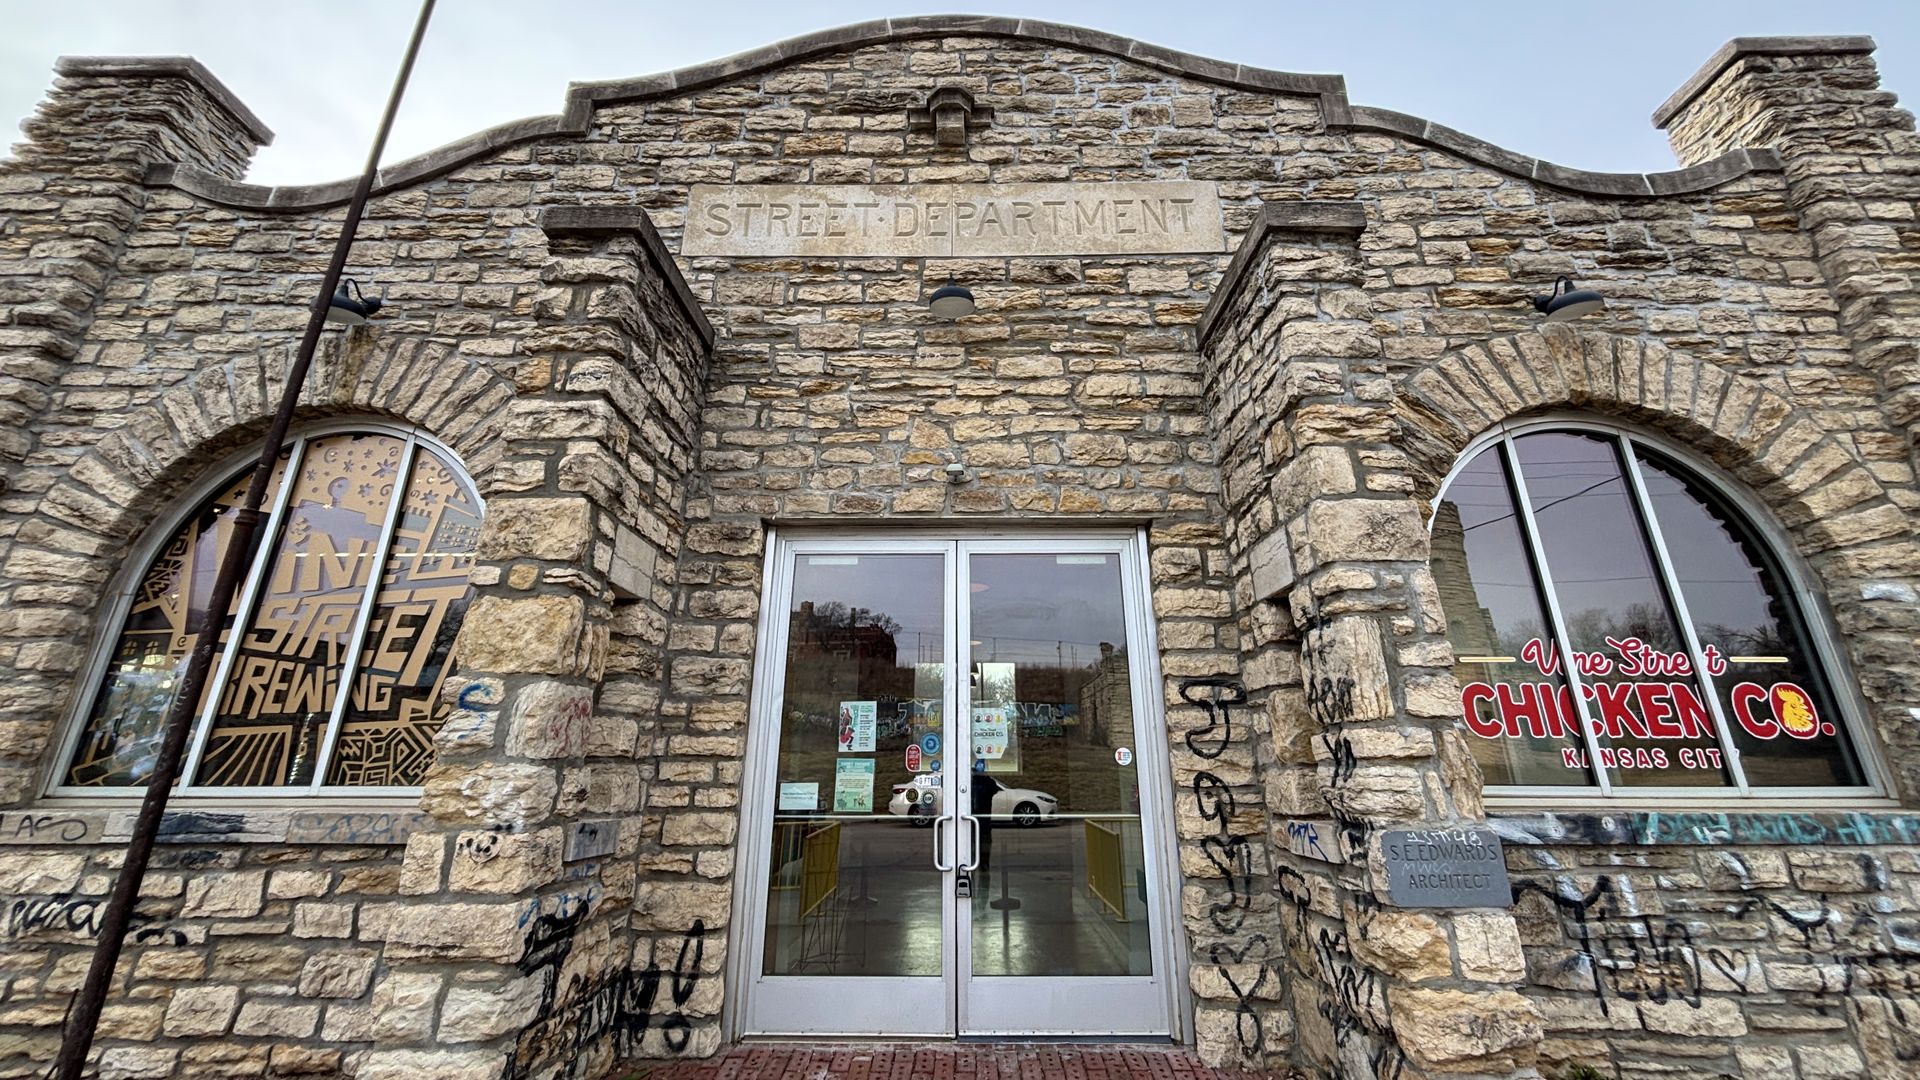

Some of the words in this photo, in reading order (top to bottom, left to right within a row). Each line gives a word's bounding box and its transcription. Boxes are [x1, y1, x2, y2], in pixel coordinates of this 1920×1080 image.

[704, 202, 880, 238] STREET
[892, 198, 1195, 238] DEPARTMENT
[1605, 636, 1727, 677] Stret
[1461, 682, 1716, 739] CHICKEN
[1731, 681, 1836, 740] CO.
[1679, 748, 1740, 769] CIT
[1409, 873, 1491, 889] ARCHITECT
